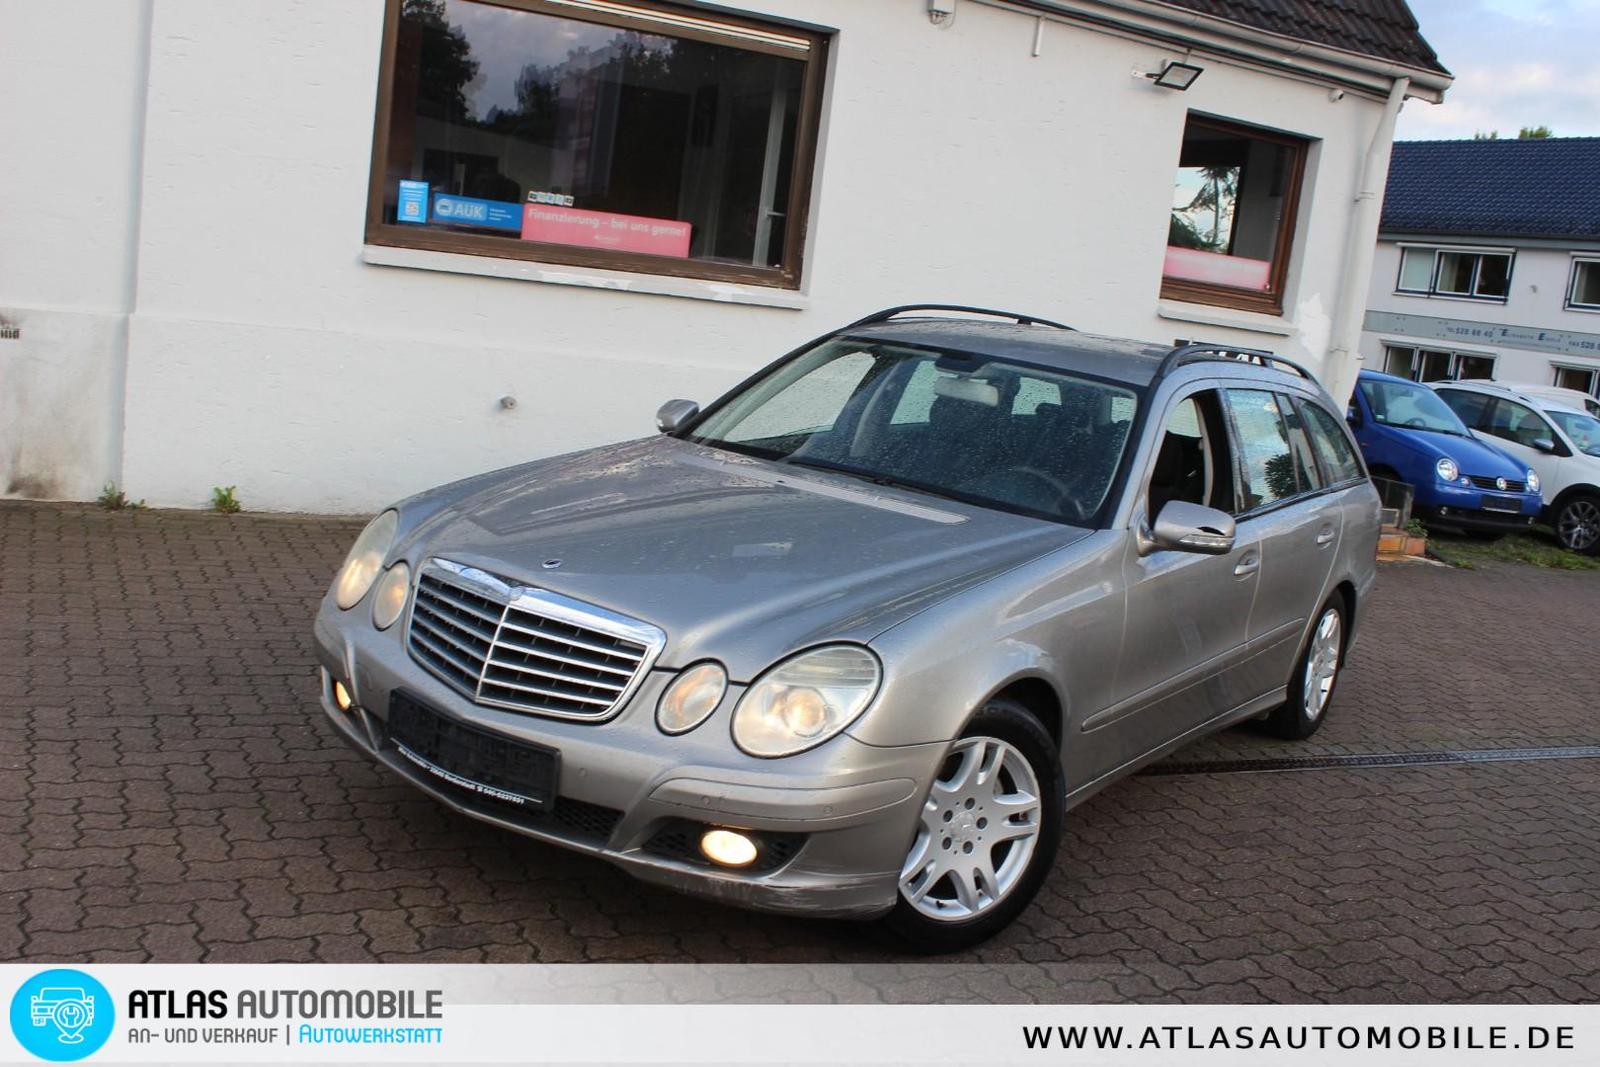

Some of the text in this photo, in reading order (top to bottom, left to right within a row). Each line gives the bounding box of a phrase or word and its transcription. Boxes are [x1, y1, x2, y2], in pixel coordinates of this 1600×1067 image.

[453, 204, 485, 219] AUK
[528, 208, 600, 229] Finanzierung
[611, 217, 628, 229] bei
[631, 223, 649, 233] uns
[652, 223, 687, 237] gerne!
